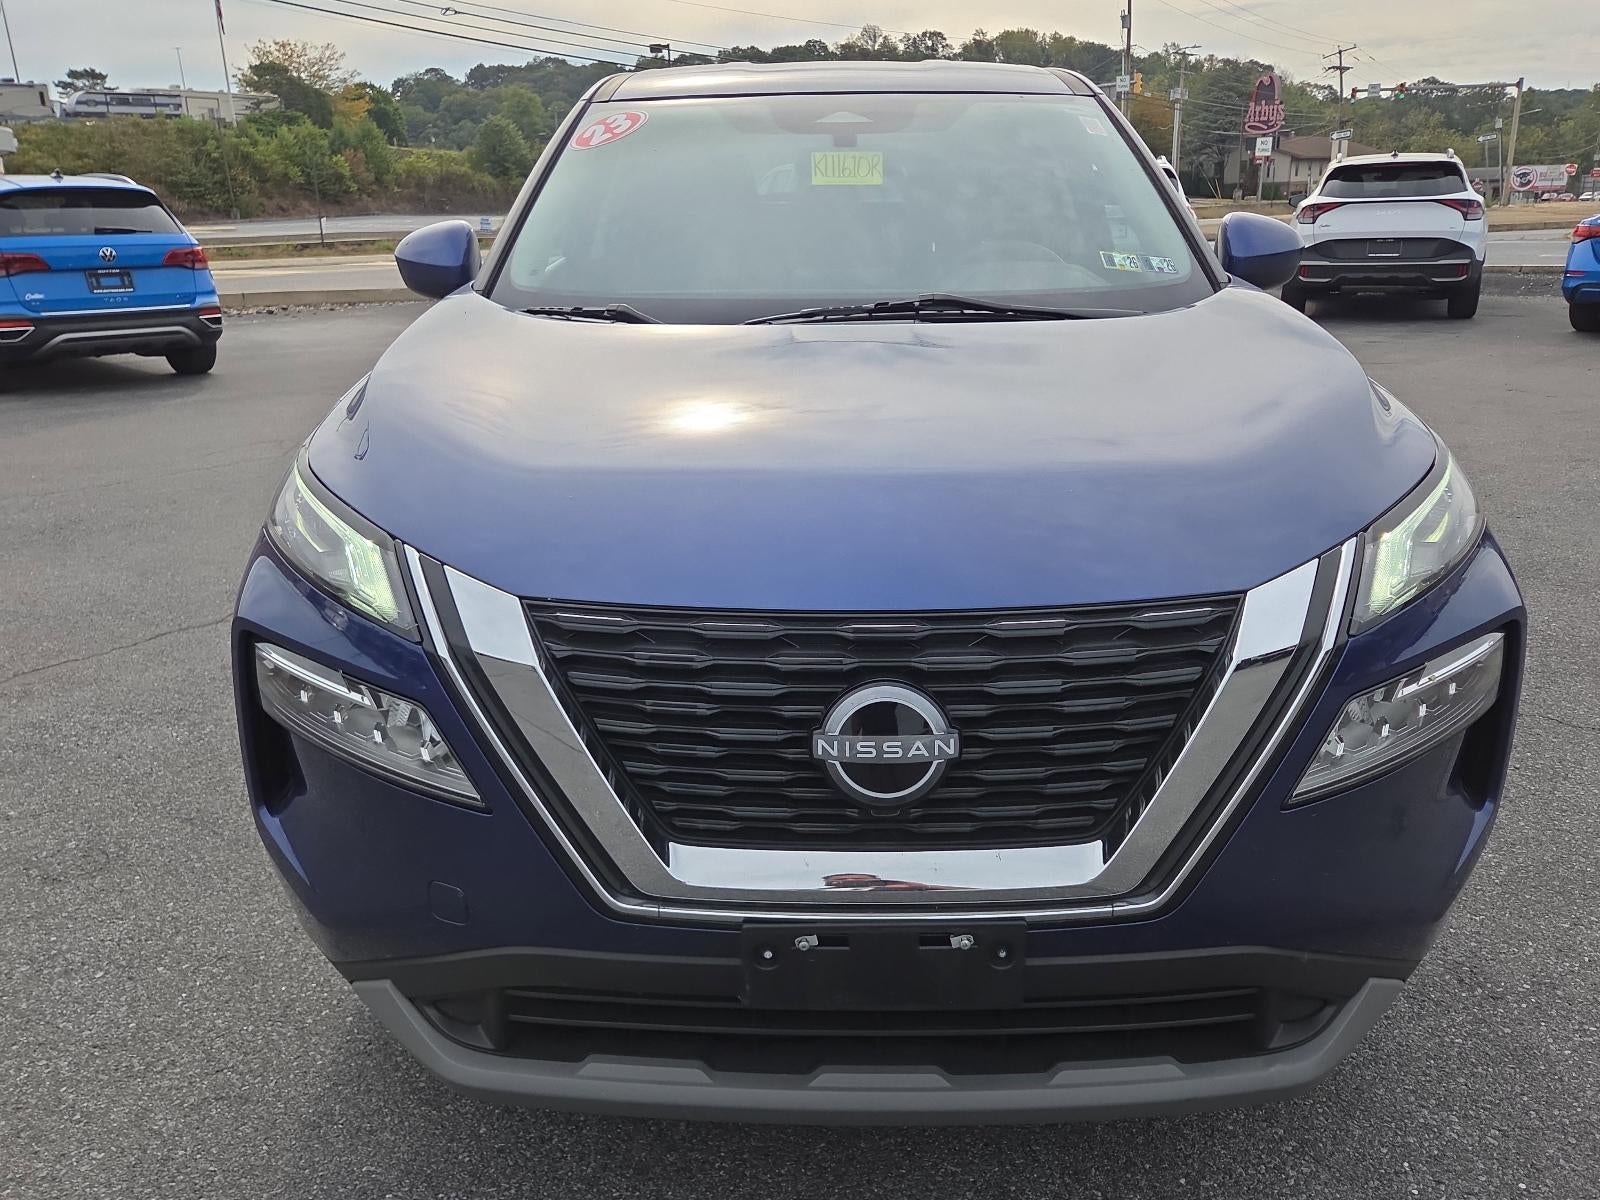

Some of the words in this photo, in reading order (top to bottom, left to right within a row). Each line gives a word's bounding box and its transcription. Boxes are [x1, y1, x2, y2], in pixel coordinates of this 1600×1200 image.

[1244, 99, 1285, 126] Arby's
[582, 113, 632, 146] 23
[817, 738, 955, 758] NISSAN
